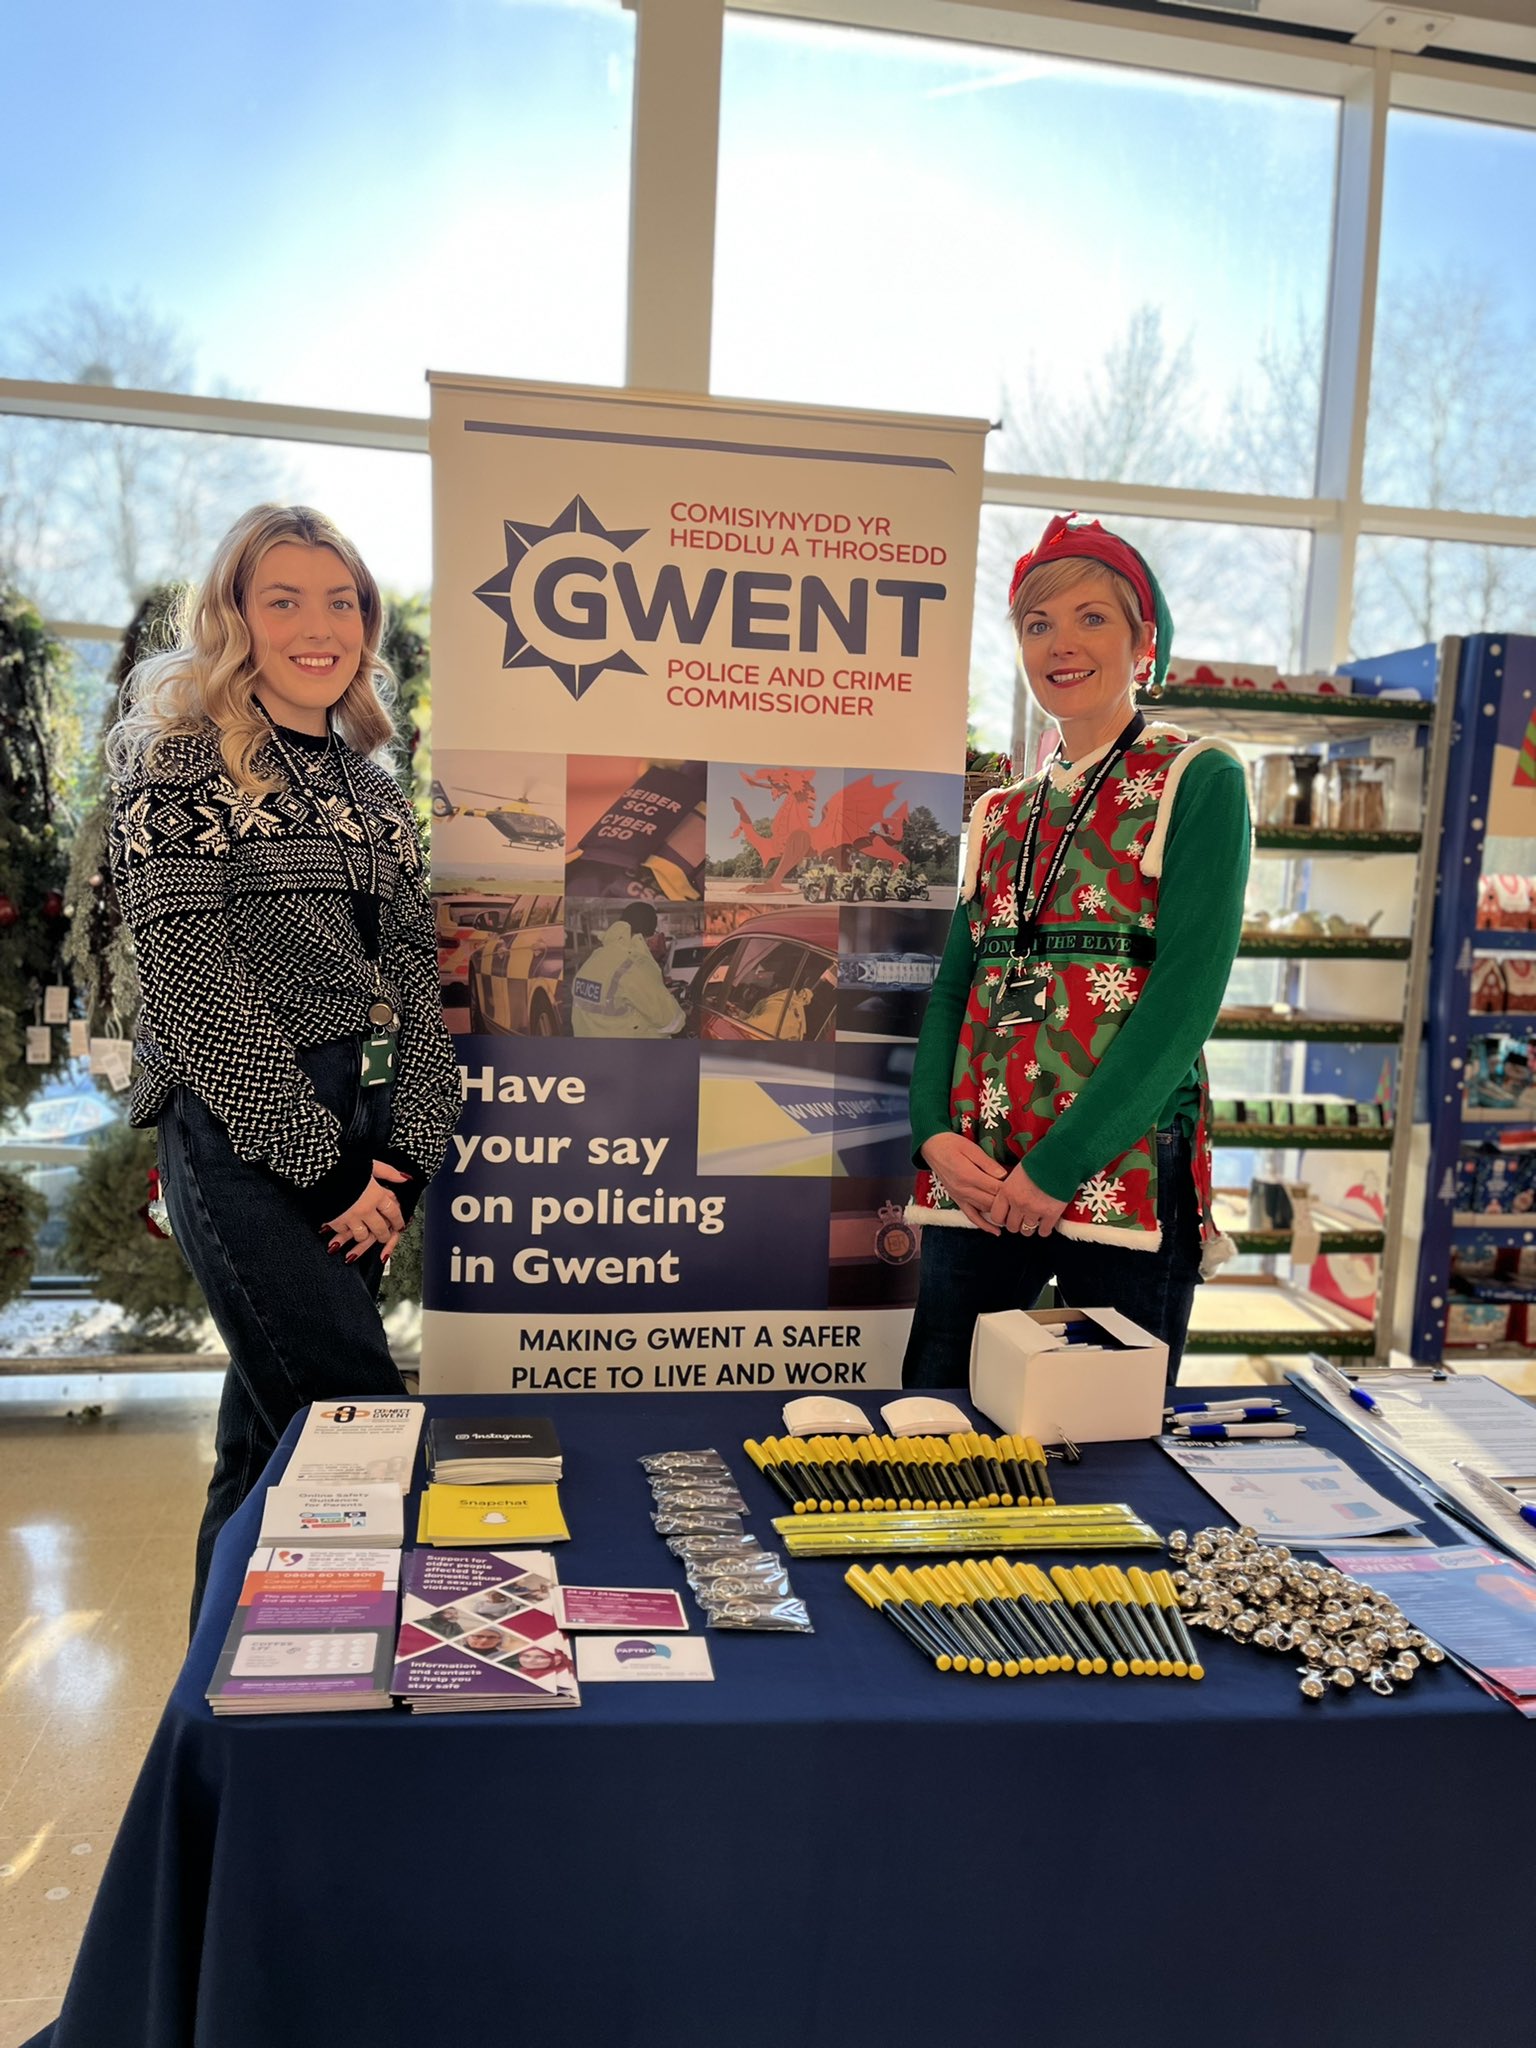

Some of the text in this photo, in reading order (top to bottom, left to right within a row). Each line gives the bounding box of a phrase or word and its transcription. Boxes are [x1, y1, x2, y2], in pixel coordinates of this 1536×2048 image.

[670, 502, 891, 536] COMISIYNYDD YR
[670, 528, 947, 566] HEDDLU A THROSEDD
[533, 556, 947, 658] GWENT
[667, 659, 912, 692] POLICE AND CRIME
[666, 686, 874, 716] COMMISSIONER
[622, 788, 682, 813] SEIBER
[622, 800, 658, 816] SCC
[598, 826, 633, 840] CSO
[600, 814, 658, 836] CYBER
[1046, 935, 1076, 949] THE
[575, 980, 600, 1000] POLICE
[457, 1065, 586, 1104] Have
[452, 1135, 670, 1175] your say
[451, 1188, 726, 1235] on policing
[450, 1246, 680, 1284] in Gwent
[519, 1325, 861, 1351] MAKING GWENT A SAFER
[511, 1362, 868, 1390] PLACE TO LIVE AND WORK
[471, 1432, 534, 1441] Instagram
[426, 1555, 469, 1563] Support
[456, 1562, 493, 1570] people
[410, 1661, 477, 1669] Information
[423, 1675, 449, 1683] help
